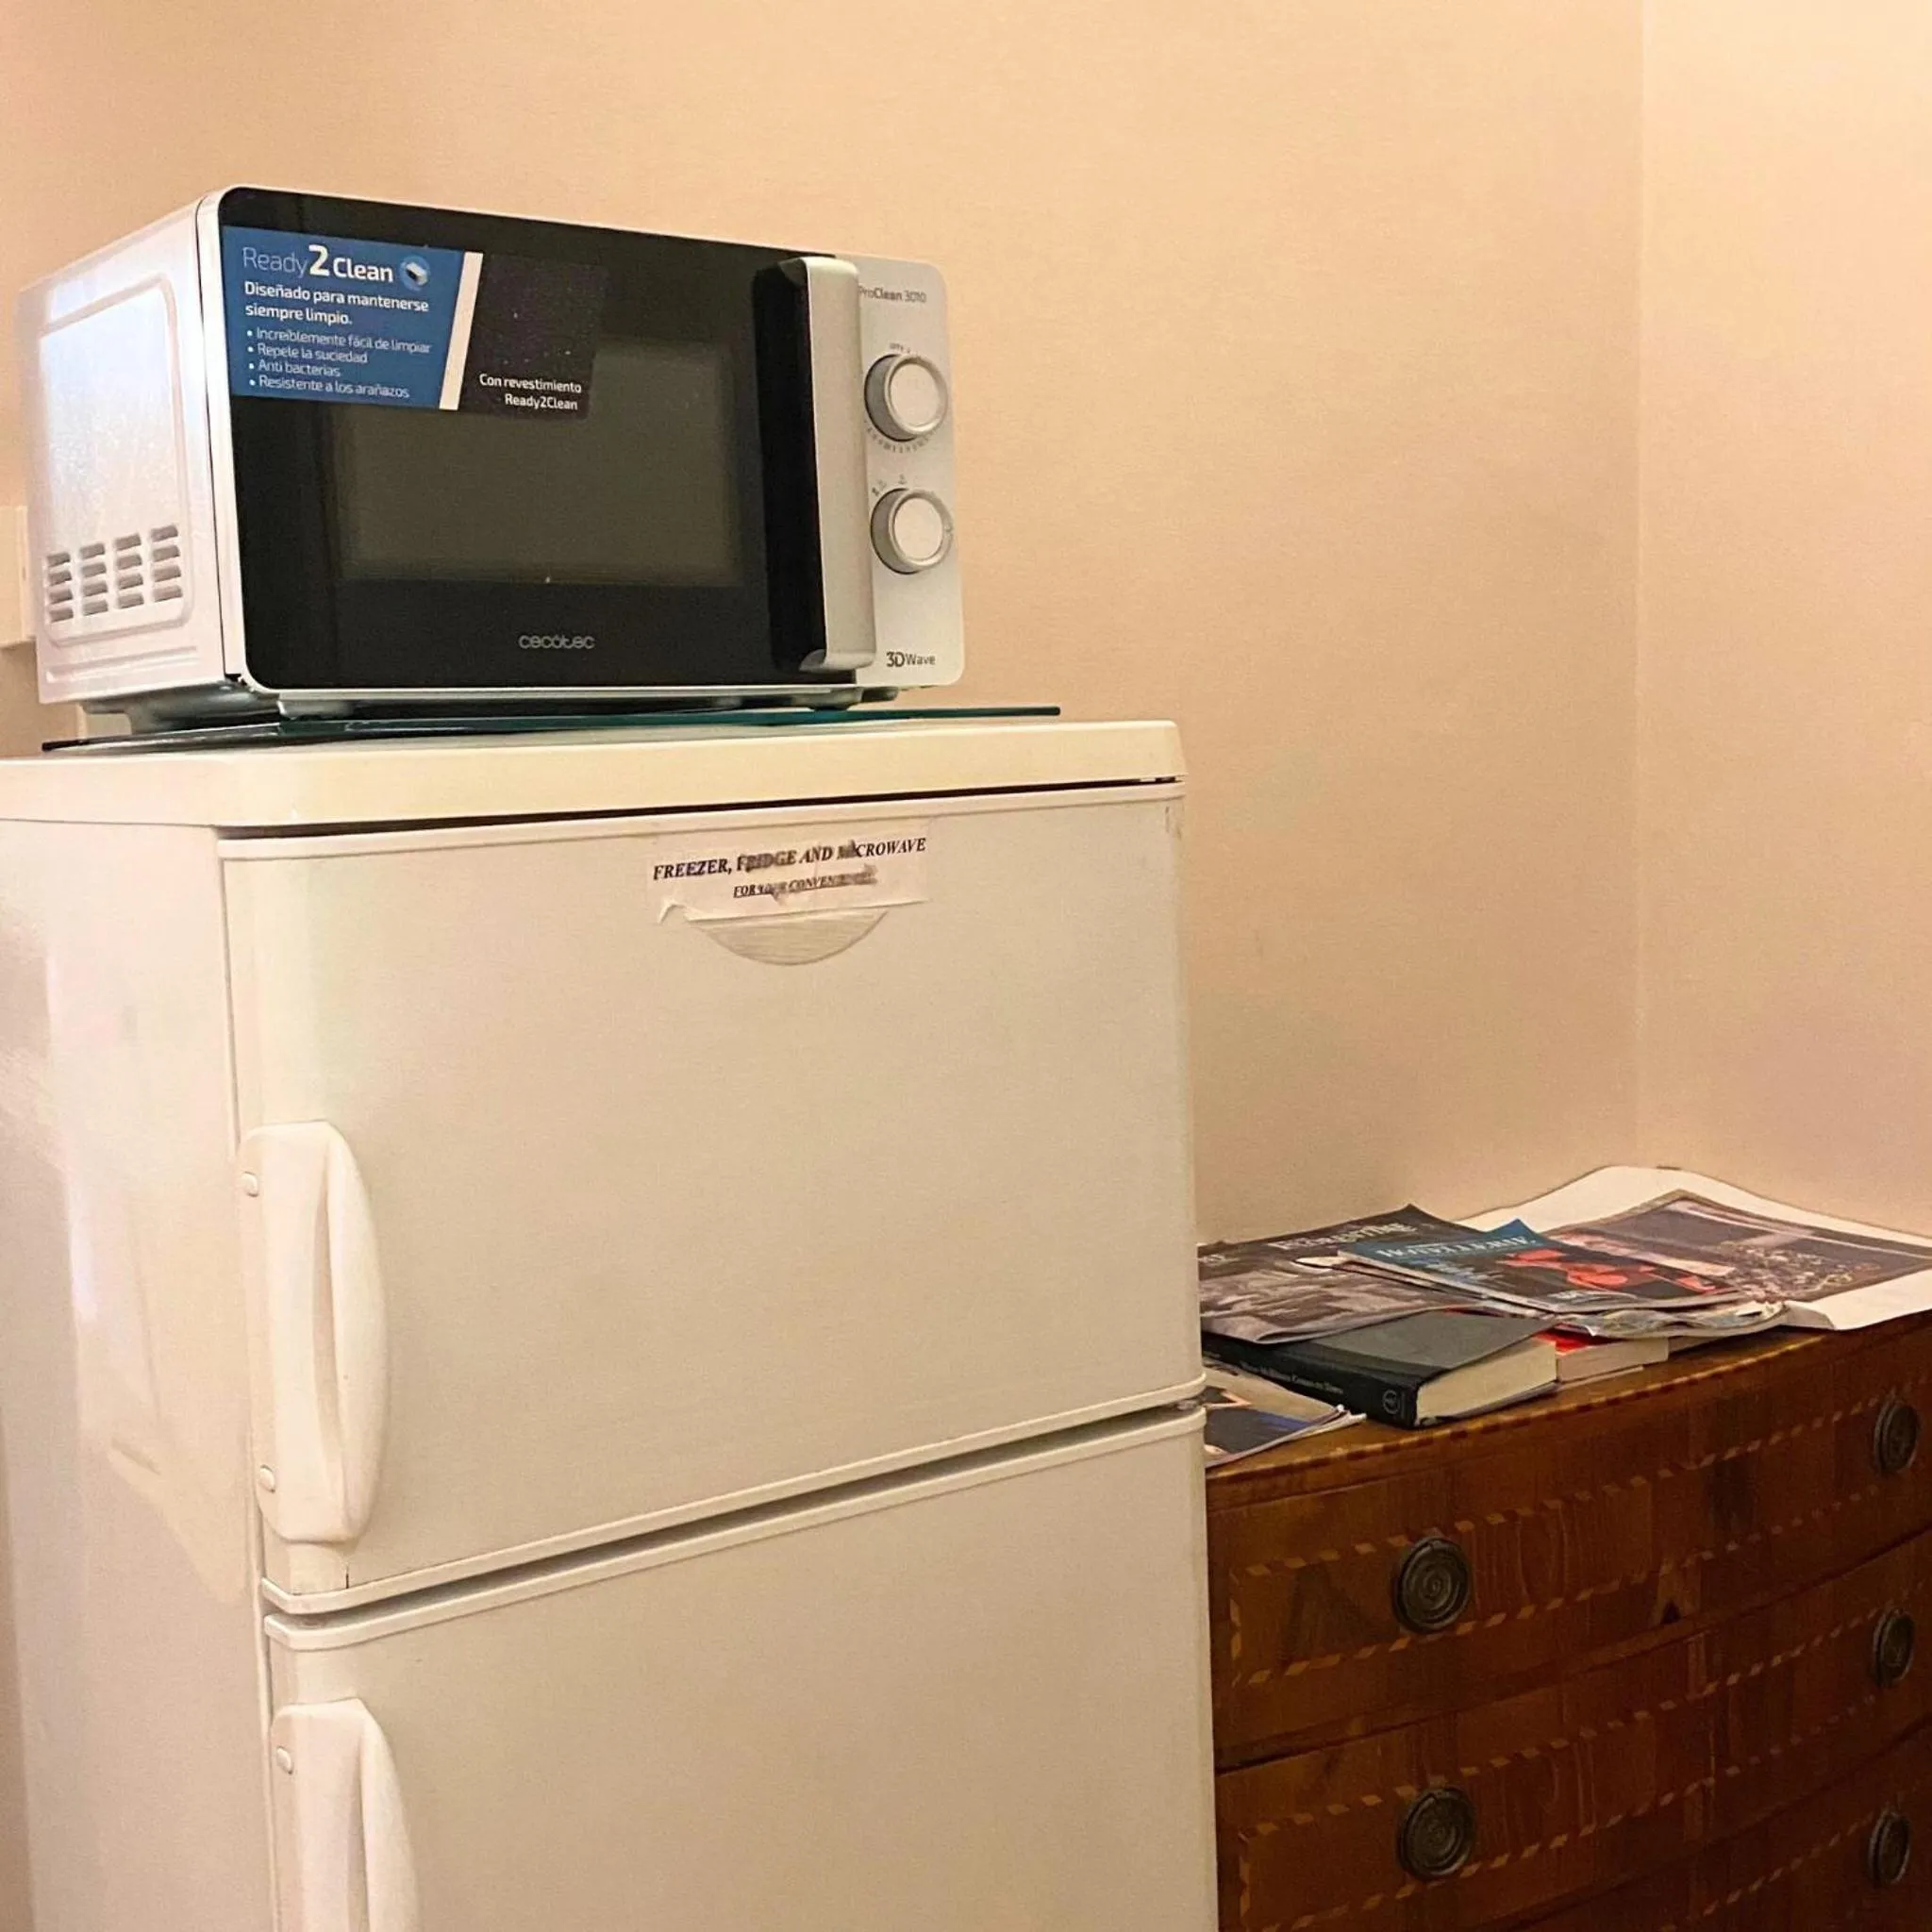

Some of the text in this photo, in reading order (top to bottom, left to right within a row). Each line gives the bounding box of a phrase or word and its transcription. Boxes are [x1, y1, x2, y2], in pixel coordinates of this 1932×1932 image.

[244, 281, 429, 312] Diseñado para mantenerse
[245, 303, 354, 326] siempre limpio.
[258, 342, 368, 364] Repele la suciedad
[375, 339, 390, 350] de
[391, 340, 432, 355] limpiar
[258, 359, 341, 377] Anti bacterias
[258, 375, 410, 398] Resistente a los arañazos
[479, 374, 582, 393] Con revestimiento
[505, 393, 578, 410] Ready2Clean
[653, 858, 732, 880] FREEZER,
[801, 845, 833, 864] AND
[732, 885, 755, 898] FOR
